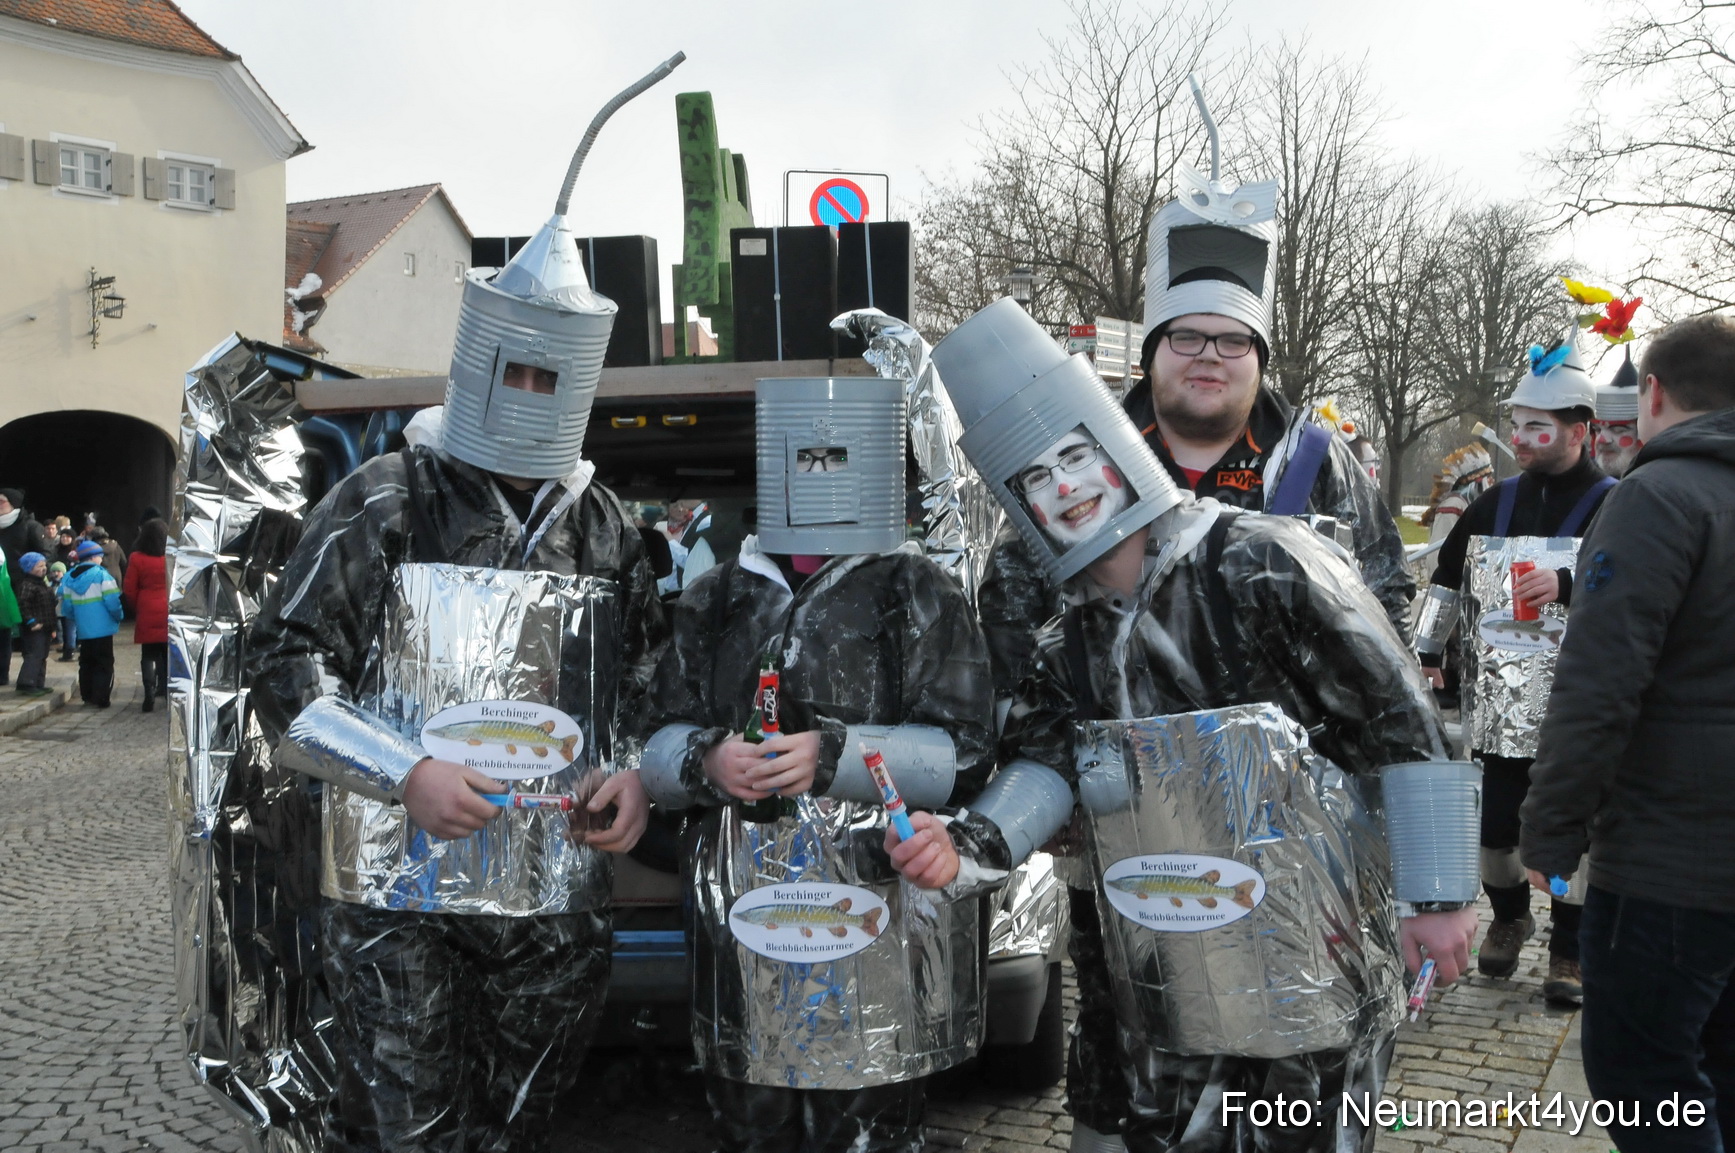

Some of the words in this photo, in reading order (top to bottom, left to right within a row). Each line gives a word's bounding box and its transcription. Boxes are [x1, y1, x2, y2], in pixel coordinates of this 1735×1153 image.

[481, 706, 539, 719] Berchinger
[464, 758, 553, 770] Blechbüchsenarmee
[1140, 861, 1198, 873] Berchinger
[773, 889, 832, 902] Berchinger
[1138, 911, 1226, 922] Blechbüchsenarmee
[765, 942, 854, 953] Blechbüchsenarmee
